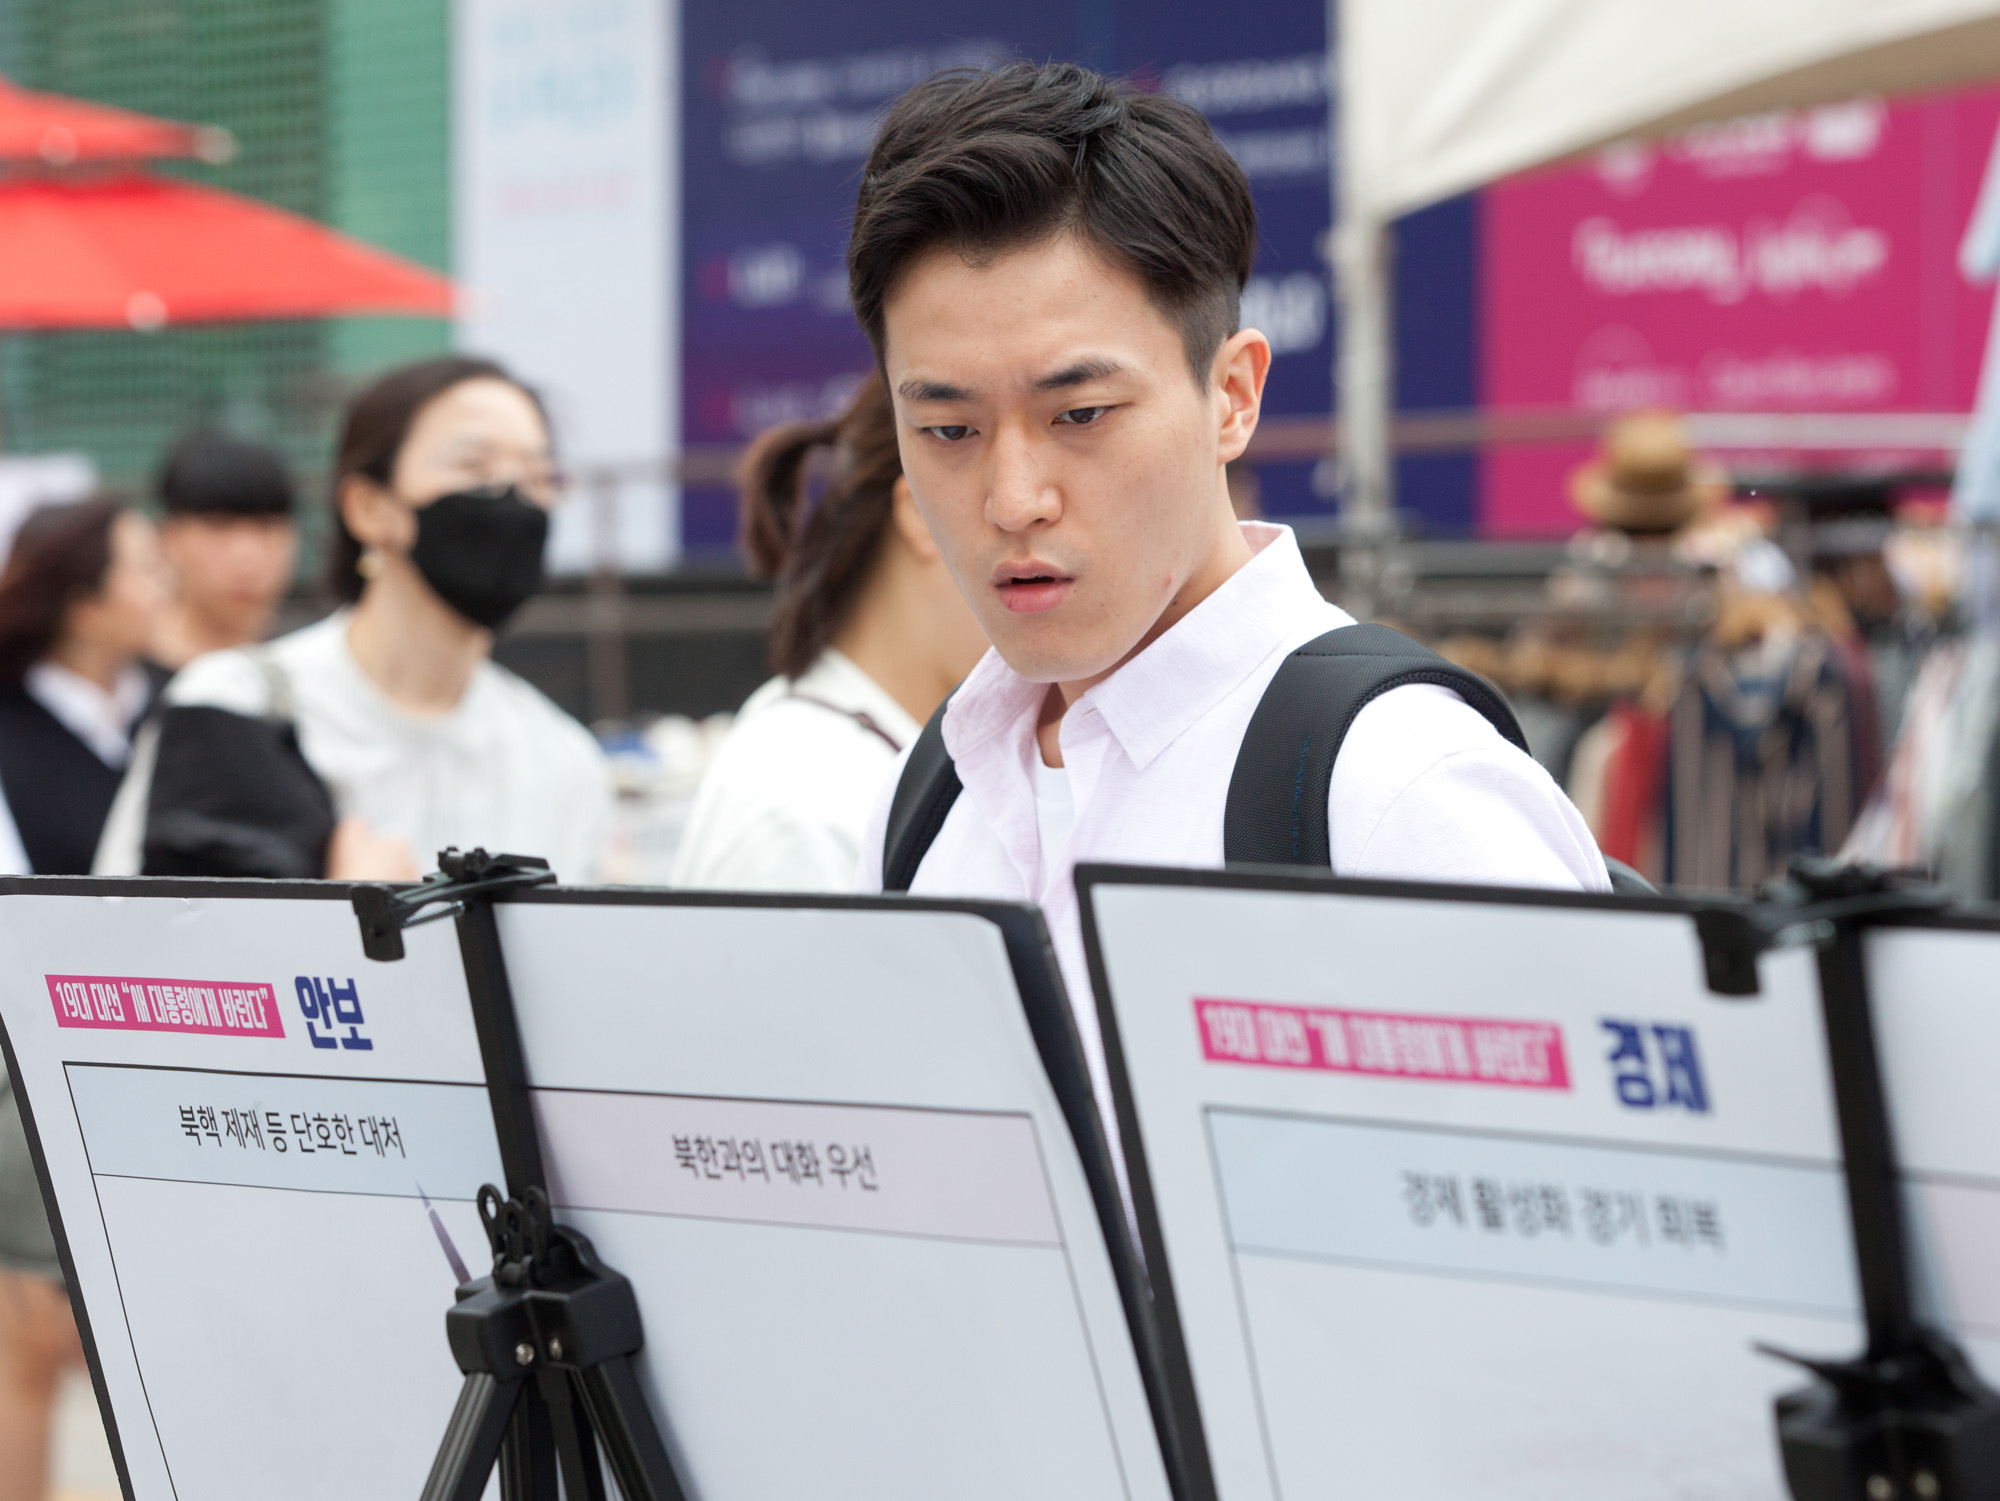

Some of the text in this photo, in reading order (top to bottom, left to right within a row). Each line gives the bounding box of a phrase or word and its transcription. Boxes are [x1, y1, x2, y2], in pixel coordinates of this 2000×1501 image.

[55, 982, 94, 1021] 19대
[90, 983, 125, 1022] 대선
[147, 985, 222, 1028] 대통령에게
[295, 976, 373, 1050] 안보
[1598, 1017, 1711, 1113] 경제
[179, 1105, 407, 1160] 북핵 제재 등 단호한 대처
[671, 1133, 880, 1193] 북한과의 대화 우선
